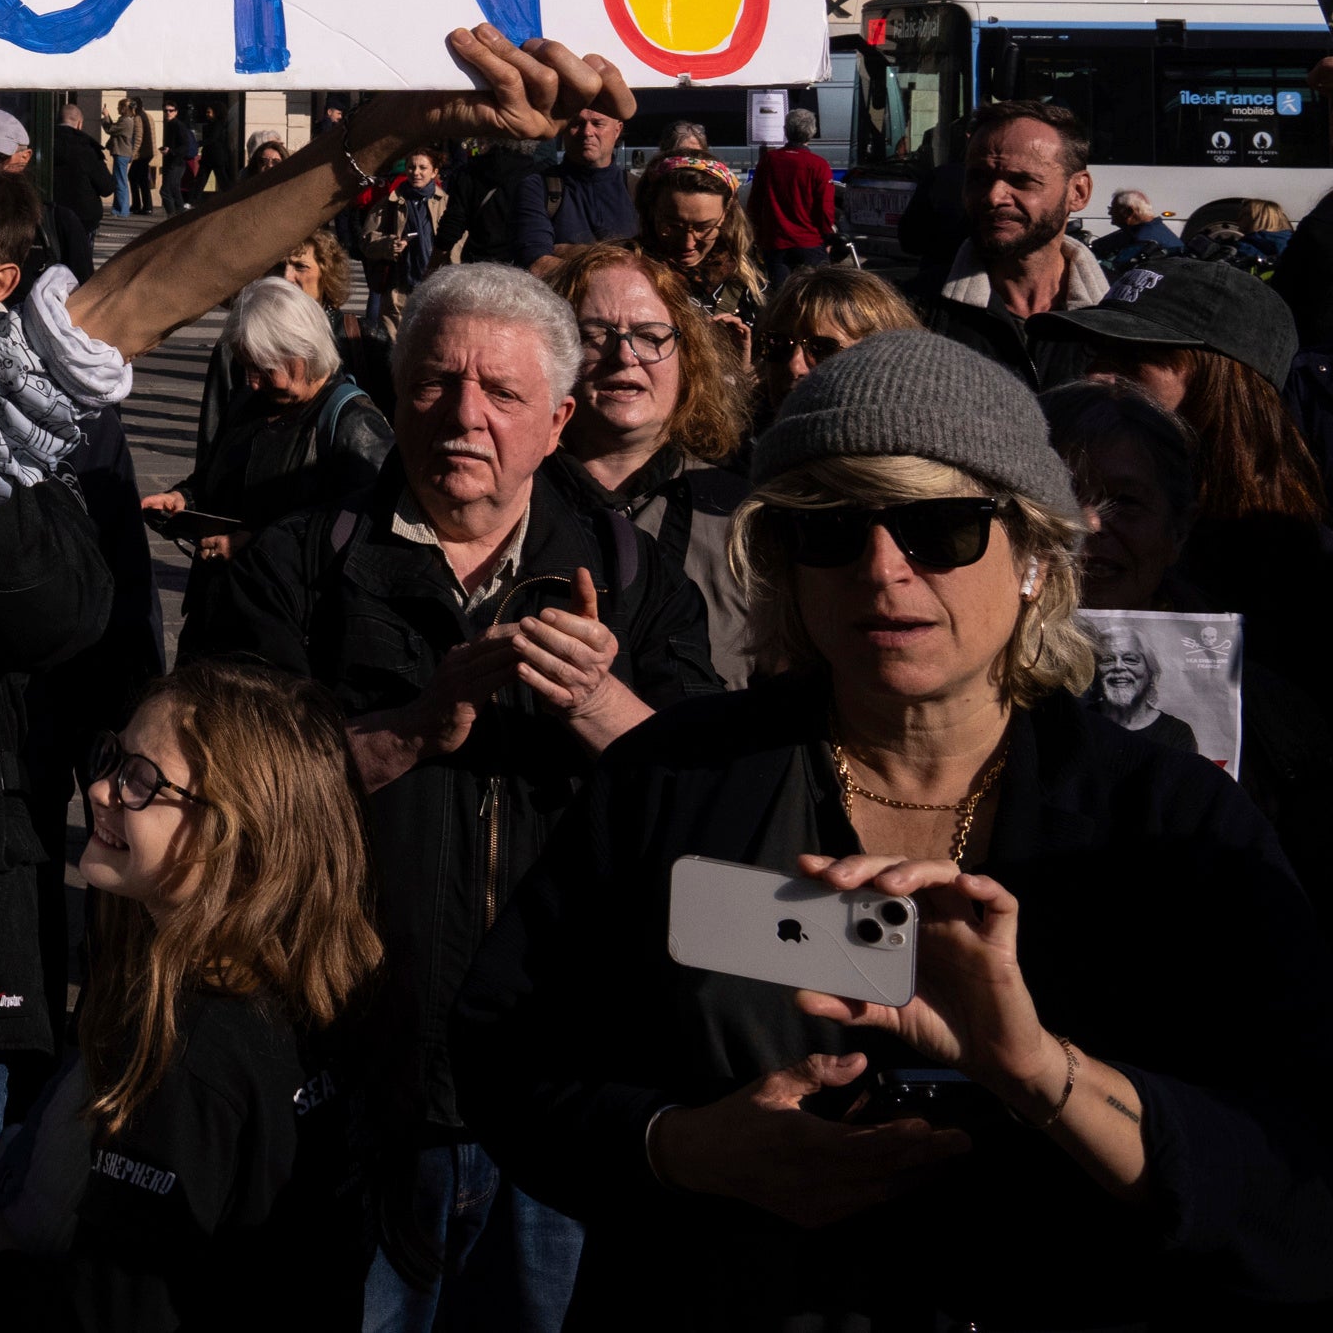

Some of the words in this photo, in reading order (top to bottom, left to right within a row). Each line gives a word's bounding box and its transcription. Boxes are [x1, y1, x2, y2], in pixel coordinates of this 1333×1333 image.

[1232, 106, 1275, 116] mobilités
[293, 1069, 337, 1116] SEA
[103, 1151, 177, 1195] SHEPHERD
